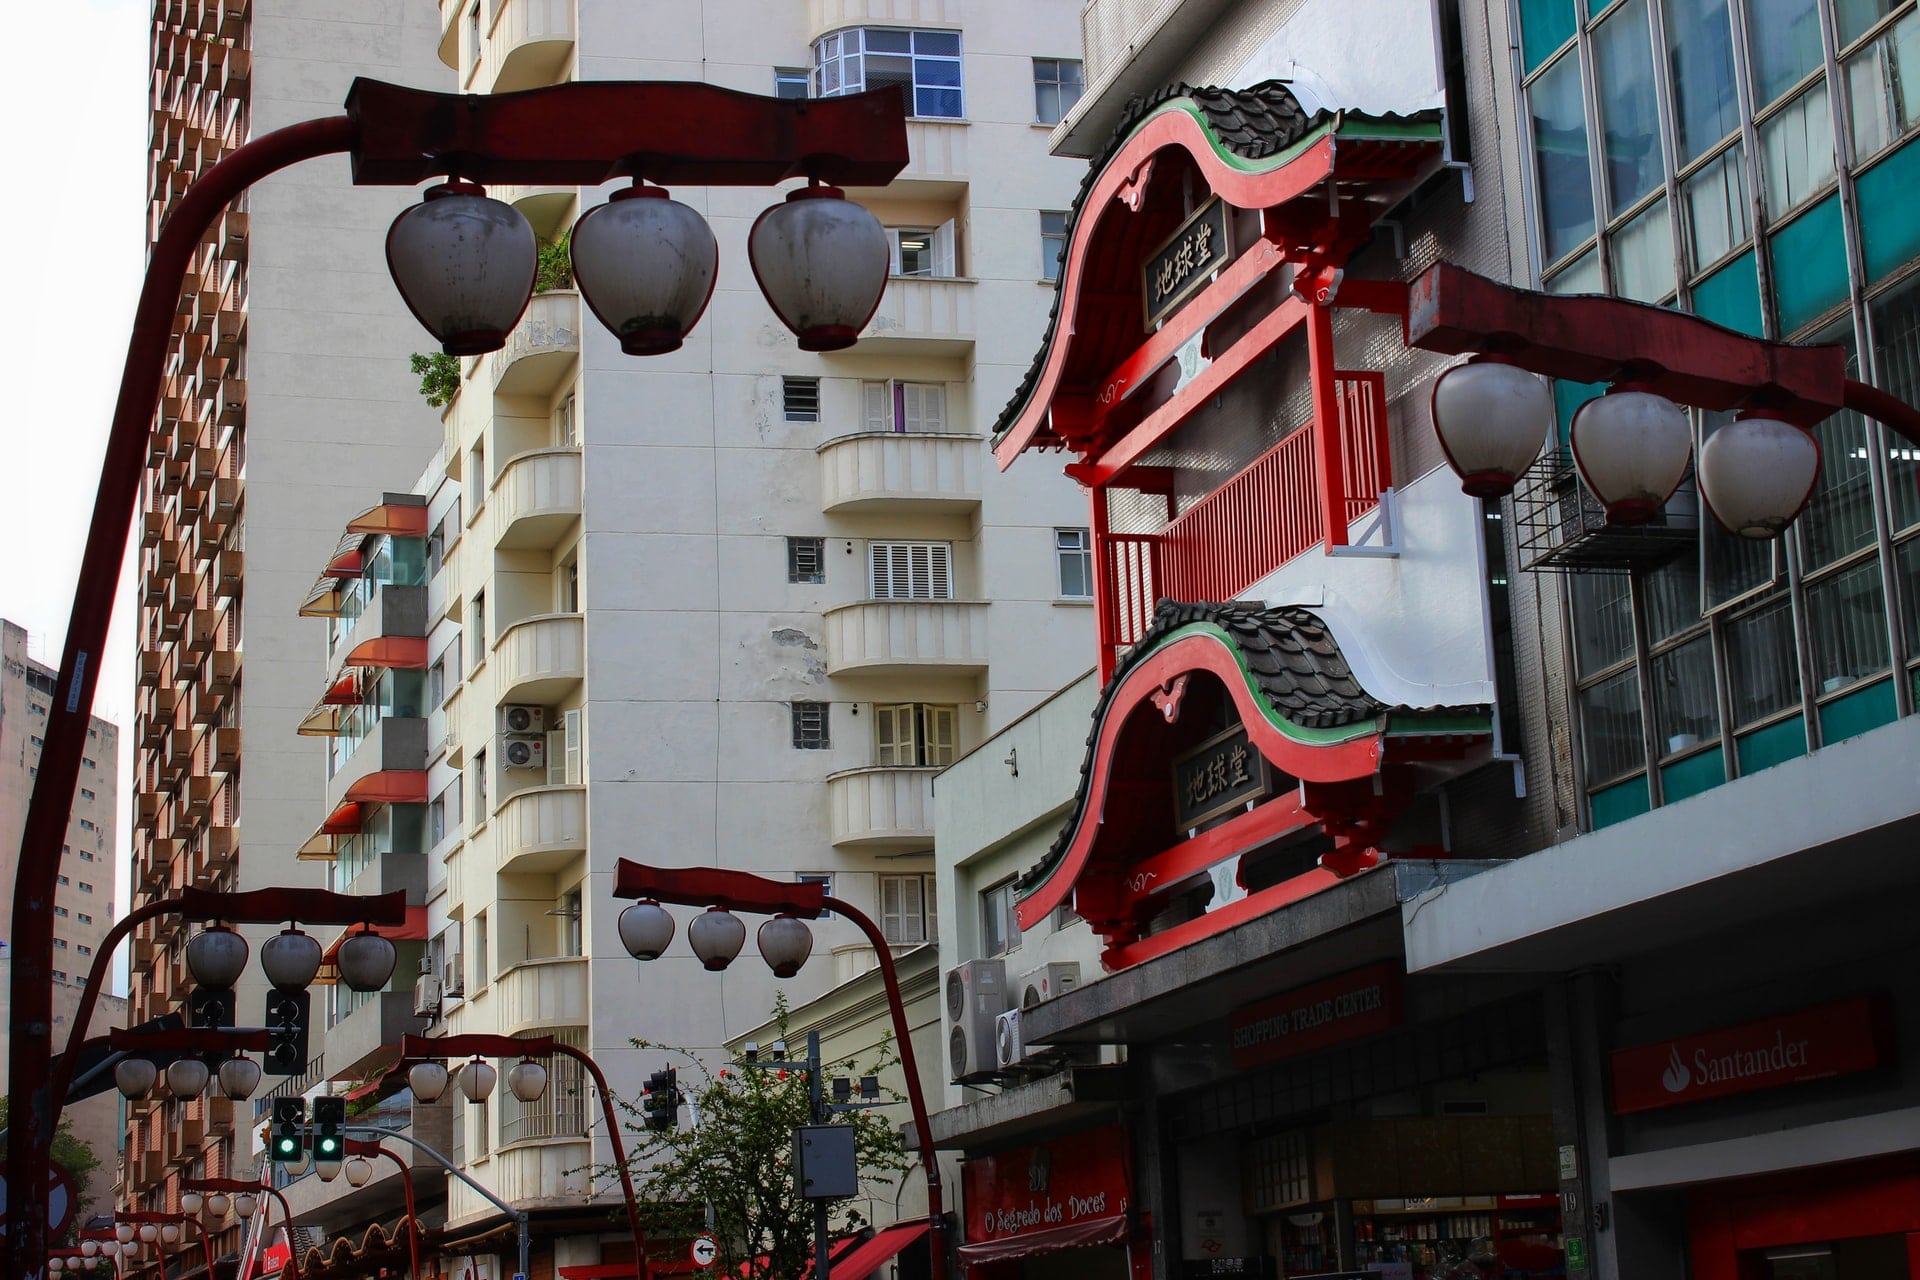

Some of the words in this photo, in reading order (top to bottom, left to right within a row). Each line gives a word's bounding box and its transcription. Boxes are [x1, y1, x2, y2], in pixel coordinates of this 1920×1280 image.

[1155, 223, 1212, 303] 地球堂
[1187, 744, 1249, 808] 地球堂
[1233, 1014, 1289, 1048] SHOPPING
[1292, 1000, 1335, 1031] TRADE
[1334, 985, 1383, 1018] CENTER
[1694, 1027, 1809, 1086] Santander
[985, 1210, 995, 1233] O
[997, 1200, 1041, 1233] Segredo
[1044, 1197, 1063, 1223] dos
[1068, 1191, 1106, 1220] Doces
[1563, 1191, 1577, 1212] 19
